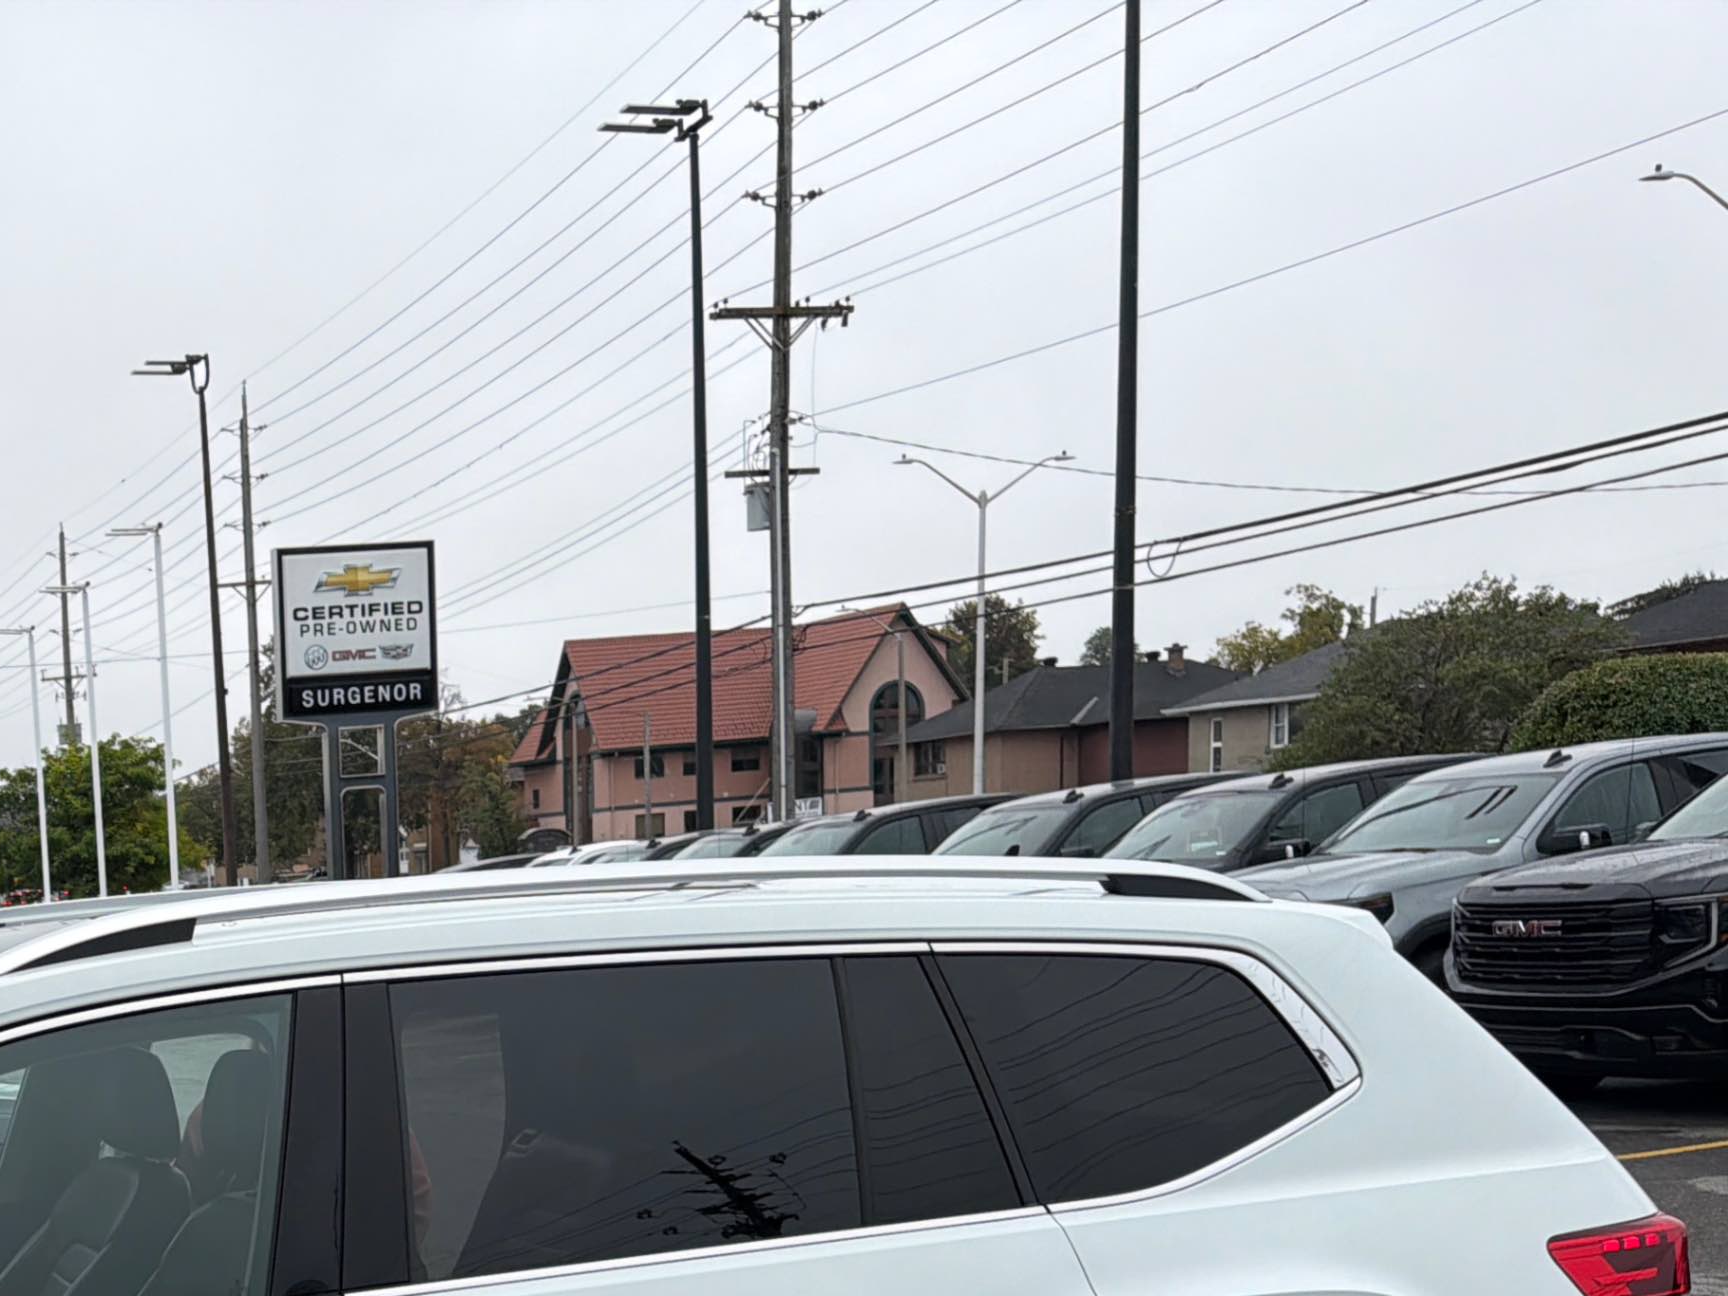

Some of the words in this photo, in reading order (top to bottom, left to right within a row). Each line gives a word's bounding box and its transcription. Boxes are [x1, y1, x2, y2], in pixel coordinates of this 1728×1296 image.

[292, 600, 423, 621] CERTIFIED
[299, 617, 418, 637] PRE-OWNED
[331, 648, 377, 661] GMC
[301, 682, 422, 708] SURGENOR
[1491, 919, 1562, 937] GMC
